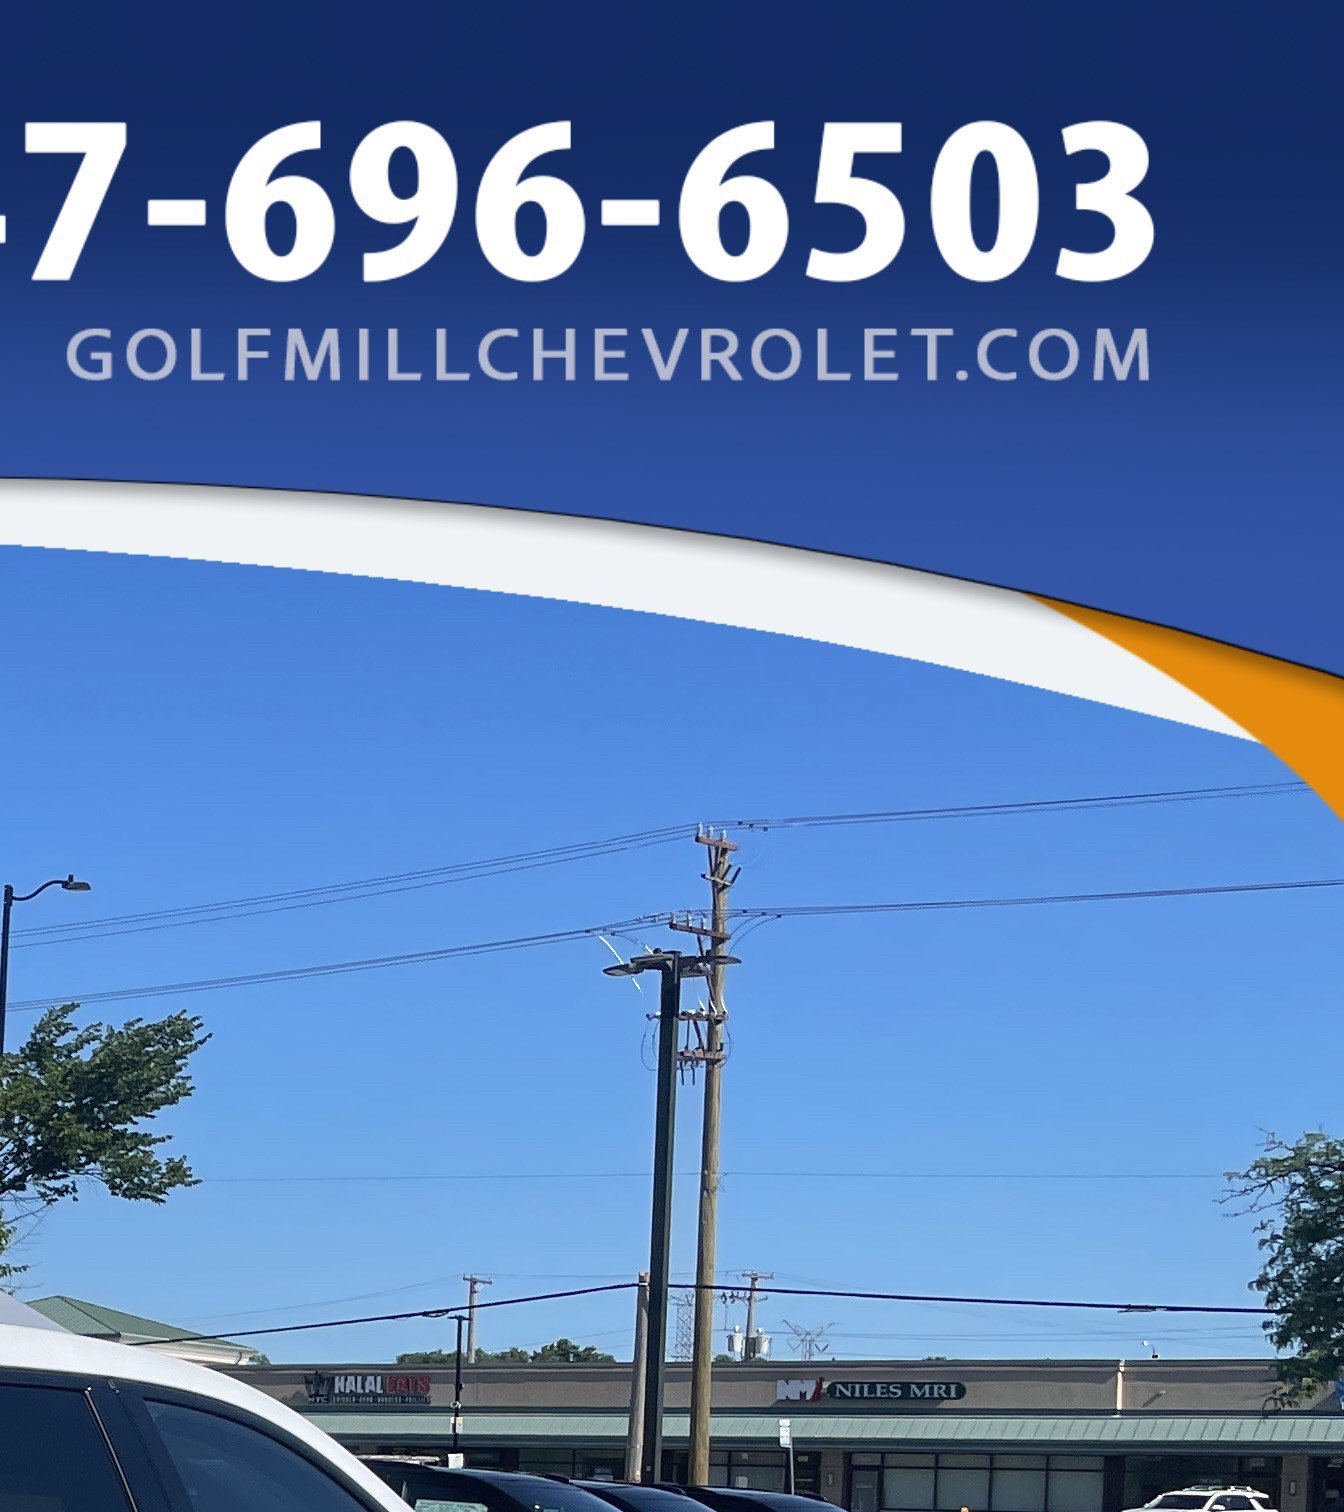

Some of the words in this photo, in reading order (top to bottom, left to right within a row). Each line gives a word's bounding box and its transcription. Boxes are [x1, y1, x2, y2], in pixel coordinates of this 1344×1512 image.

[334, 1375, 383, 1394] HALAL
[386, 1375, 431, 1396] EATS
[835, 1383, 902, 1398] NILES
[910, 1383, 957, 1398] MRI
